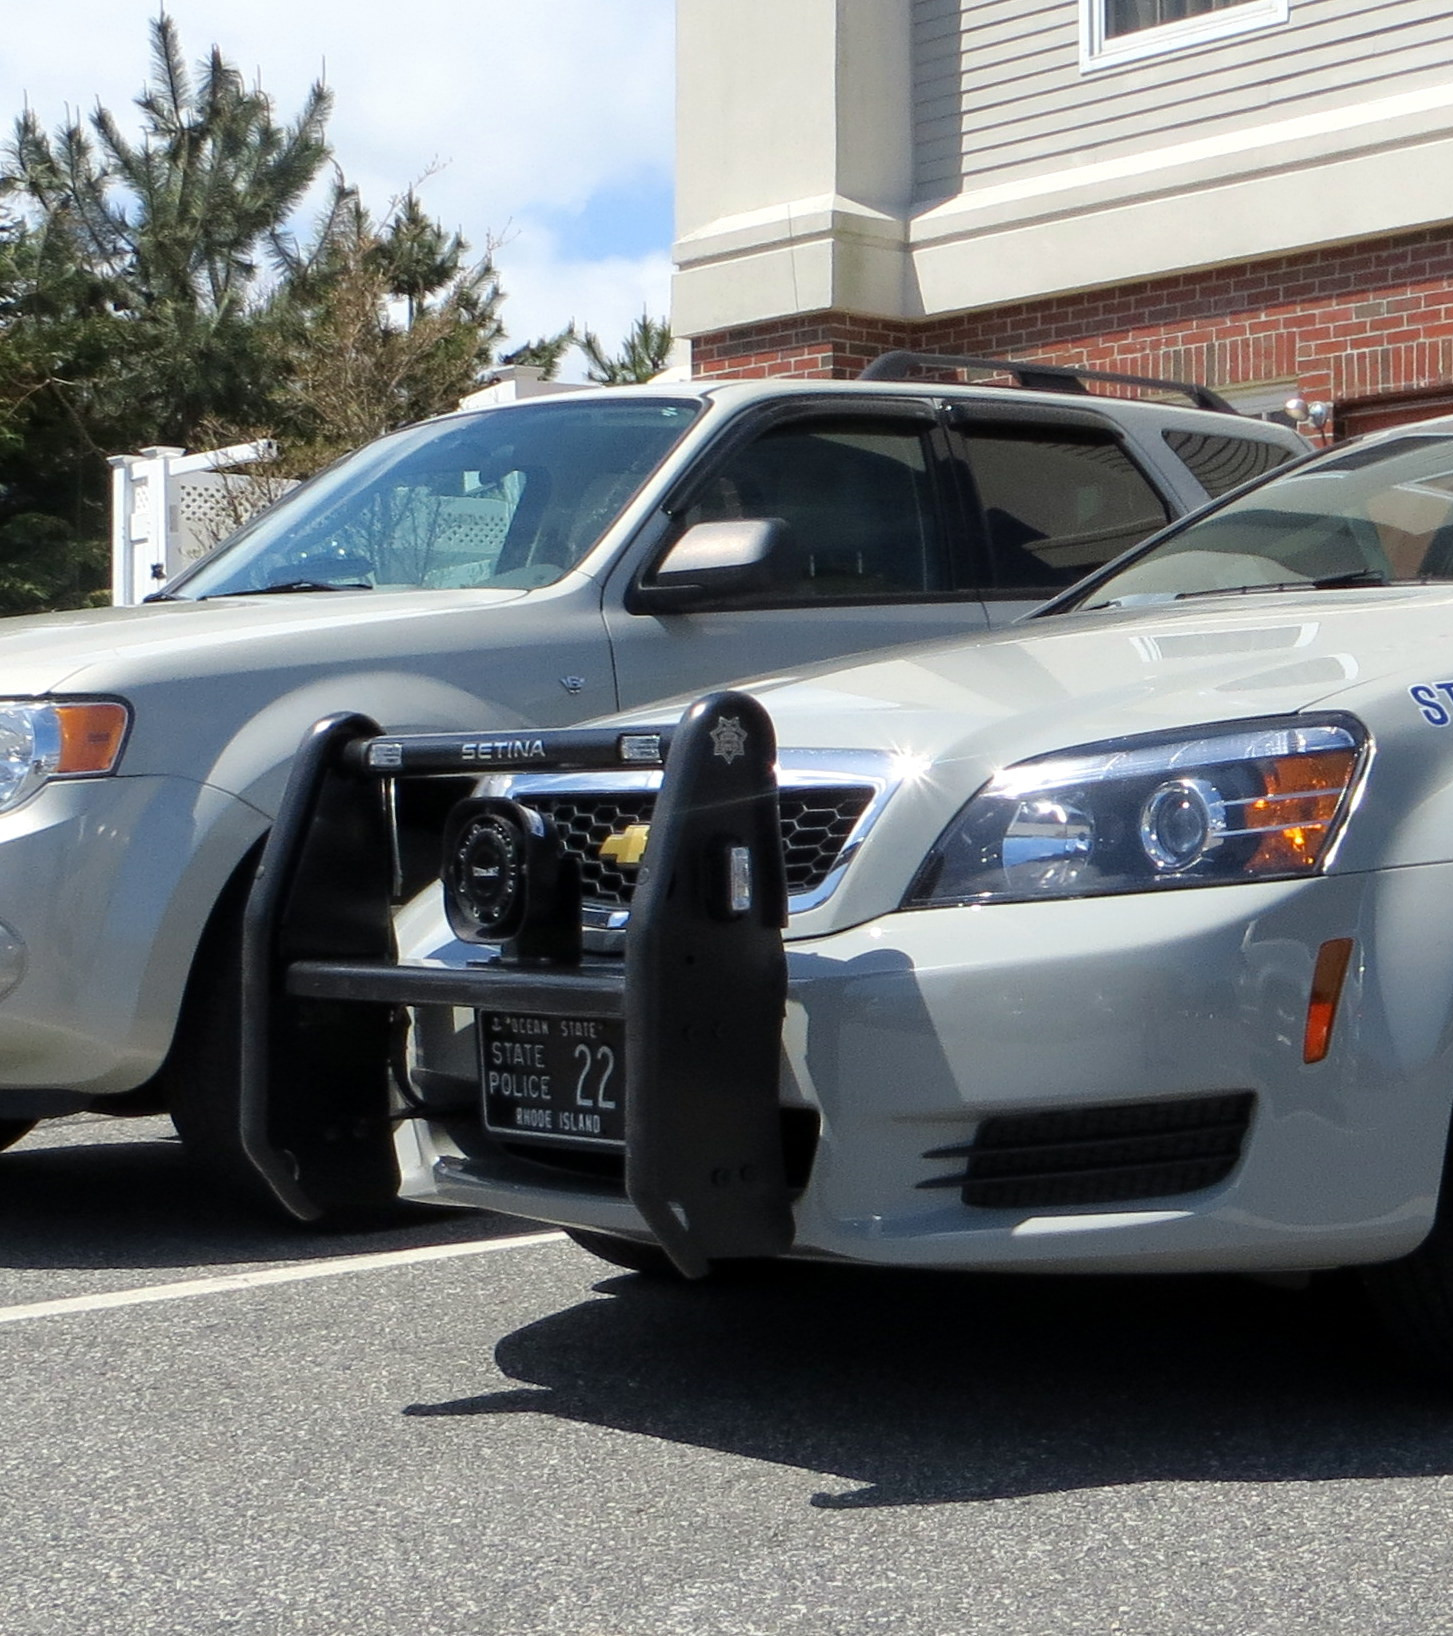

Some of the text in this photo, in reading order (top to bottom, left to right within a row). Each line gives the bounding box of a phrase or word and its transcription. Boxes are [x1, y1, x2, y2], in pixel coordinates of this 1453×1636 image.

[461, 739, 546, 760] SETINA
[491, 1041, 545, 1068] STATE
[488, 1070, 551, 1099] POLICE
[574, 1043, 617, 1109] 22
[516, 1107, 601, 1134] RHODE ISLAND
